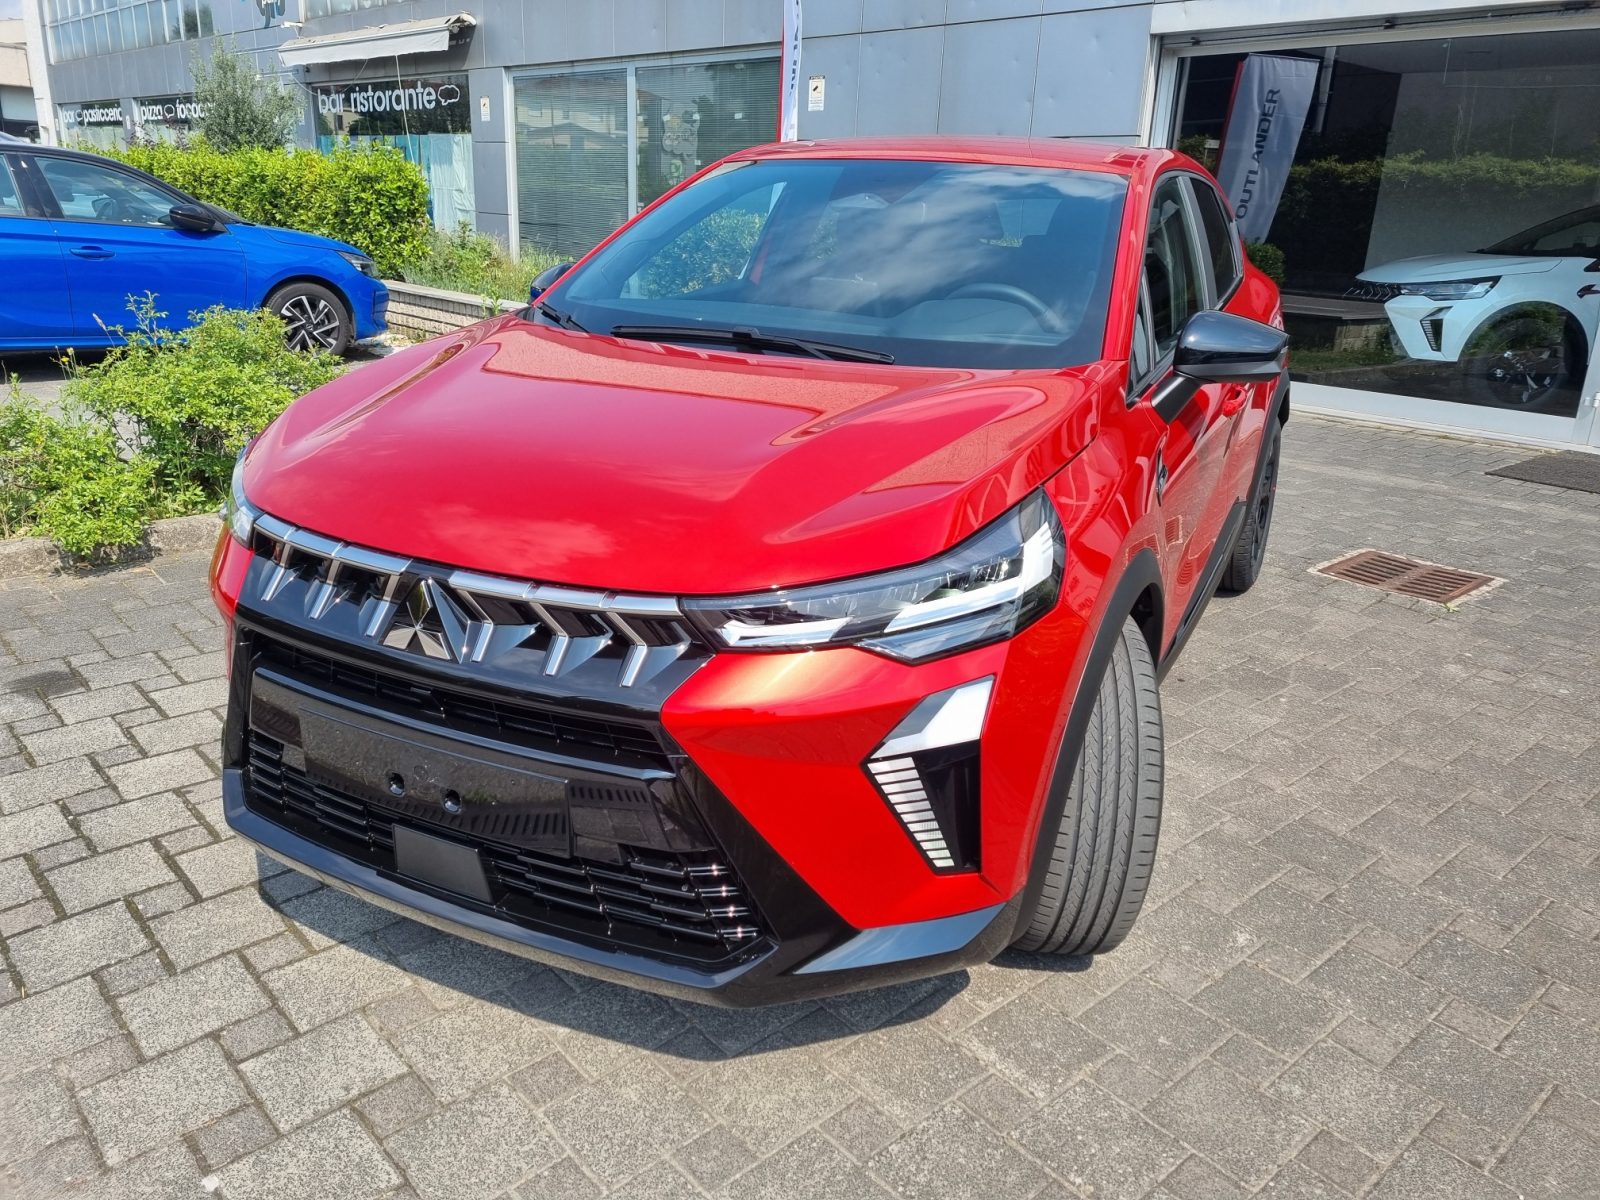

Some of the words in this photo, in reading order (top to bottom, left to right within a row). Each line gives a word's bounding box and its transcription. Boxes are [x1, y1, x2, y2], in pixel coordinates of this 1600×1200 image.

[318, 88, 345, 114] bar
[350, 80, 437, 113] ristorante
[1235, 88, 1281, 220] OUTLANDER
